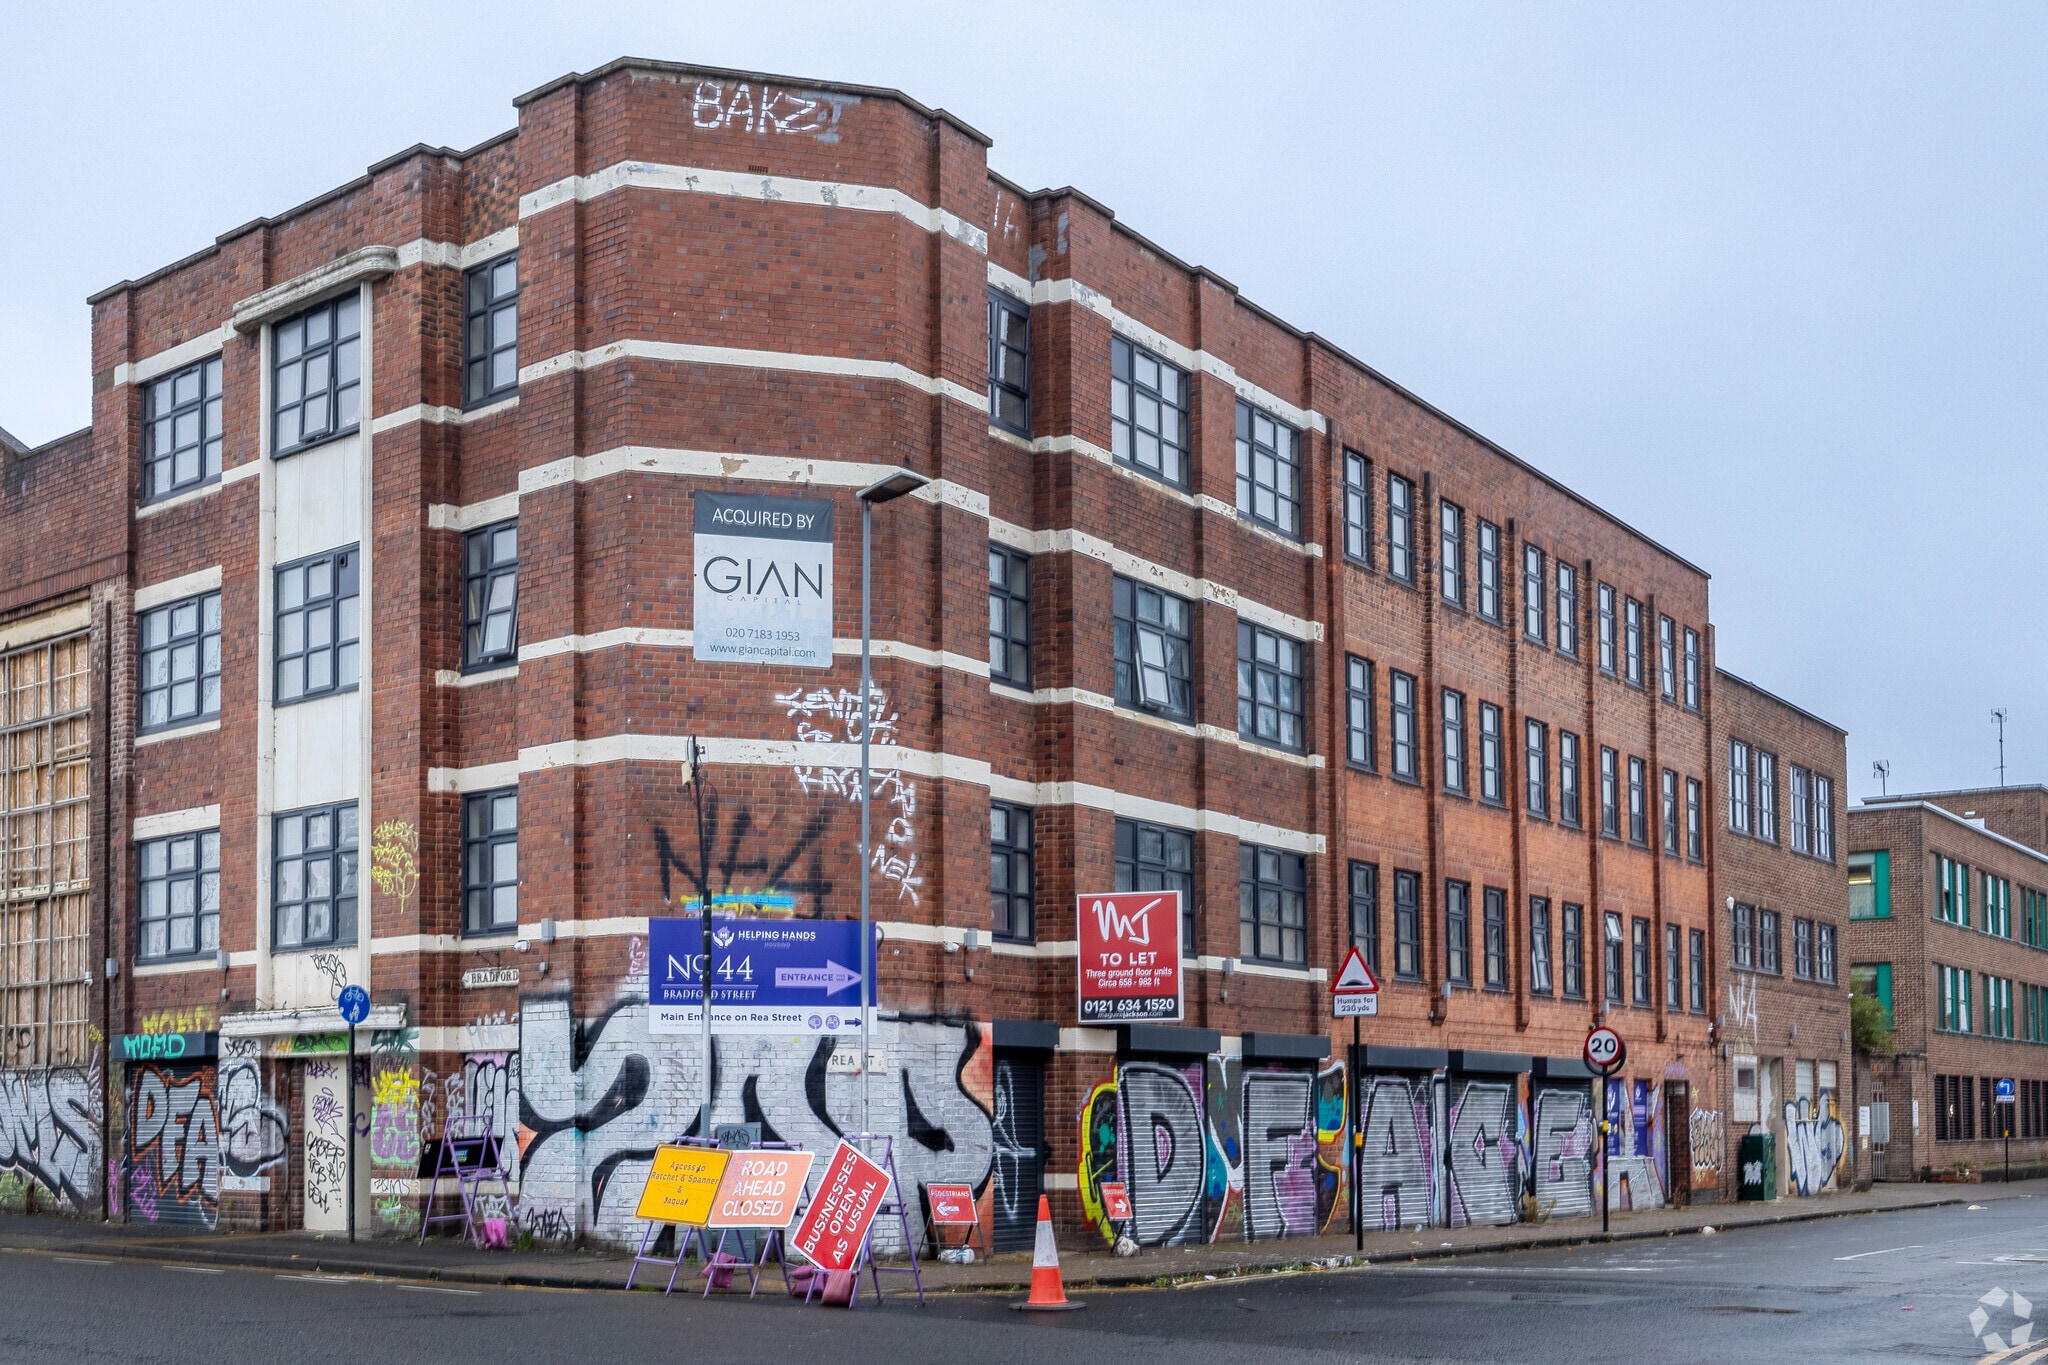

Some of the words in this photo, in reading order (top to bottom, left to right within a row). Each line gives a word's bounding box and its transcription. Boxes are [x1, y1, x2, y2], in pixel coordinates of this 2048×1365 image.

[712, 508, 792, 527] ACQUIRED
[796, 515, 815, 530] BY
[703, 556, 823, 599] GIAN
[726, 595, 801, 606] CAPITAL
[725, 628, 745, 638] 020
[748, 629, 773, 640] 7183
[776, 630, 800, 641] 1953
[710, 643, 816, 658] www.giancapital.com
[738, 930, 779, 940] HELPING
[782, 931, 816, 941] HANDS
[1100, 952, 1122, 966] TO
[1129, 951, 1157, 966] LET
[717, 954, 753, 981] 44
[1086, 969, 1106, 978] Three
[1108, 968, 1133, 978] ground
[1135, 967, 1152, 977] floor
[1154, 966, 1173, 976] units
[471, 970, 519, 984] BRADFORD
[781, 973, 834, 981] ENTRANCE
[1098, 979, 1117, 989] Circa
[1119, 978, 1132, 988] 658
[1154, 978, 1161, 987] ft
[663, 989, 719, 1000] BRADFOD
[720, 989, 757, 1000] STREET
[1337, 997, 1361, 1005] Humps
[1363, 996, 1374, 1004] for
[1084, 1000, 1113, 1013] 0121
[1117, 999, 1142, 1011] 634
[1144, 998, 1175, 1011] 1520
[1357, 1004, 1370, 1013] yds
[660, 1012, 684, 1021] Main
[687, 1012, 732, 1021] Entance
[750, 1013, 769, 1021] Rea
[772, 1013, 802, 1022] Street
[1591, 1037, 1616, 1053] 20
[832, 1055, 855, 1066] REA
[670, 1162, 695, 1172] Access
[697, 1164, 706, 1172] to
[741, 1160, 789, 1177] ROAD
[651, 1171, 678, 1182] Ratchet
[680, 1174, 686, 1182] &
[688, 1174, 719, 1185] Spanner
[677, 1185, 682, 1194] &
[731, 1180, 786, 1197] AHEAD
[930, 1190, 970, 1198] PEDESTRIANS
[722, 1200, 785, 1217] CLOSED
[803, 1151, 859, 1255] BUSINESSES
[829, 1188, 858, 1236] OPEN
[832, 1237, 848, 1265] AS
[846, 1179, 877, 1234] USUAL
